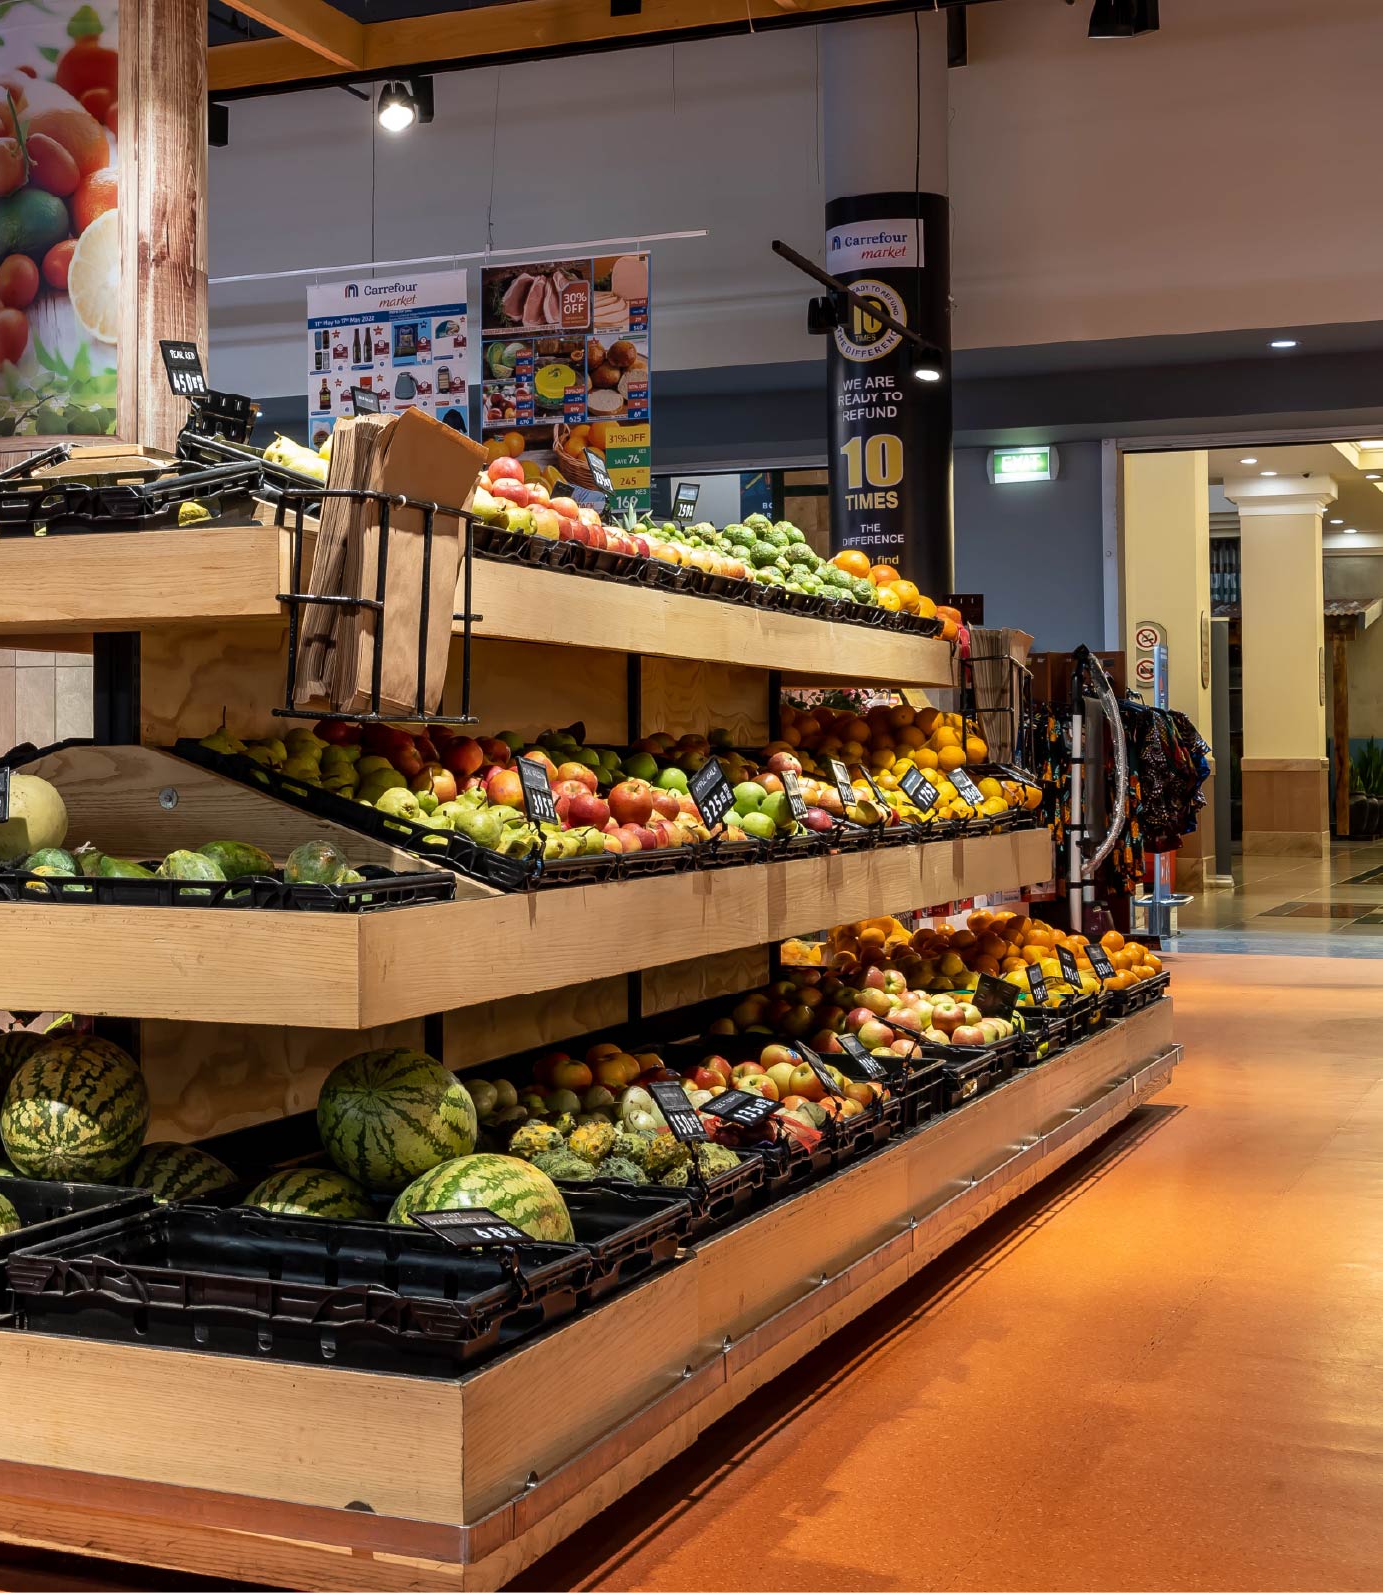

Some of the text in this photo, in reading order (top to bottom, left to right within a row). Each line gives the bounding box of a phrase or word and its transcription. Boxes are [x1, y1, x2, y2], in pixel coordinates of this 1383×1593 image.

[844, 231, 908, 248] Carrefour
[861, 245, 907, 260] market
[364, 282, 418, 296] Carrefour
[378, 294, 418, 308] market
[563, 292, 587, 304] 30%
[563, 304, 584, 314] OFF
[842, 375, 895, 391] WE ARE
[837, 391, 903, 407] READY TO
[842, 405, 898, 422] REFUND
[628, 454, 640, 465] 76
[839, 433, 904, 490] 10
[620, 477, 637, 486] 245
[844, 490, 899, 511] TIMES
[860, 523, 881, 533] THE
[843, 533, 905, 547] DIFFERENCE
[877, 554, 899, 566] find
[702, 794, 722, 824] 325
[733, 1106, 764, 1122] 135
[670, 1113, 693, 1135] 150
[473, 1226, 507, 1239] 68
